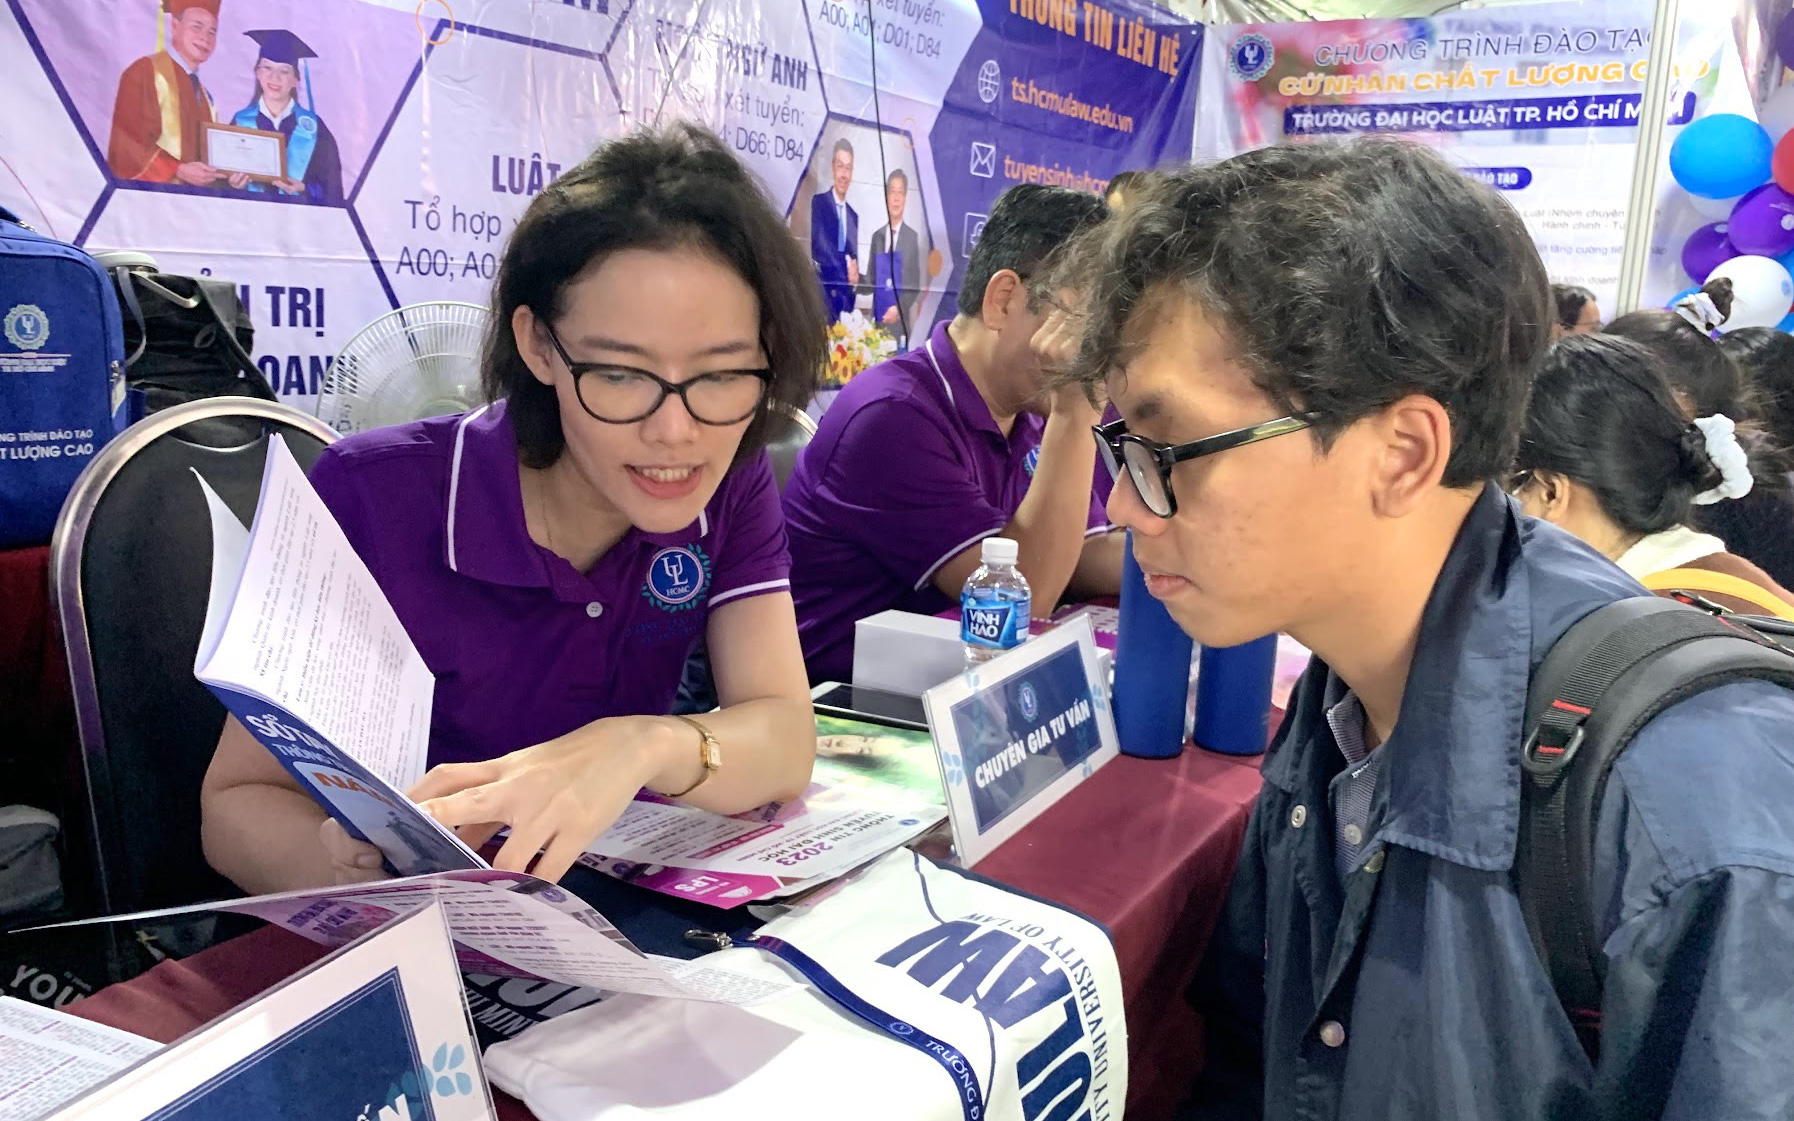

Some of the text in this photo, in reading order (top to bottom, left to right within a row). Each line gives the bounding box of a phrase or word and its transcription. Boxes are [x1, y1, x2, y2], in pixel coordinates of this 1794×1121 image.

[916, 33, 942, 60] D84
[1083, 1, 1114, 51] TIN
[1117, 16, 1156, 68] LIÊN
[1158, 33, 1181, 84] HỆ
[1315, 28, 1650, 66] CHƯƠNG TRÌNH ĐÀO TẠ
[771, 53, 808, 91] ANH
[1326, 70, 1406, 95] NHÂN
[1507, 62, 1625, 87] LƯỢNG
[755, 94, 805, 127] tuyển:
[1012, 76, 1134, 133] ts.hcmulaw.edu.vn
[1292, 109, 1371, 129] TRƯỜNG
[1375, 112, 1408, 129] ĐẠI
[1412, 109, 1453, 129] HỌC
[1457, 105, 1509, 127] LUẬT
[1513, 106, 1541, 123] TP.
[1547, 100, 1578, 121] HỒ
[1584, 98, 1622, 119] CHÍ
[775, 135, 804, 162] D84
[404, 195, 502, 243] Tổ hợp
[395, 246, 454, 282] A00;
[265, 285, 324, 337] TRỊ
[10, 444, 62, 462] LƯỢNG
[64, 443, 94, 457] CAO
[975, 740, 1027, 788] CHUYÊN
[1027, 725, 1051, 754] GIA
[1065, 697, 1091, 728] VẤN
[813, 827, 840, 840] SINH
[830, 831, 852, 842] TIN
[851, 814, 895, 833] THÔNG
[758, 850, 788, 862] HỌC
[776, 841, 833, 866] 2023
[674, 875, 719, 892] LPS
[961, 912, 1012, 927] LAW
[1009, 922, 1045, 938] OF
[1043, 936, 1109, 1079] UNIVERSITY
[926, 1040, 977, 1103] TRƯỜNG
